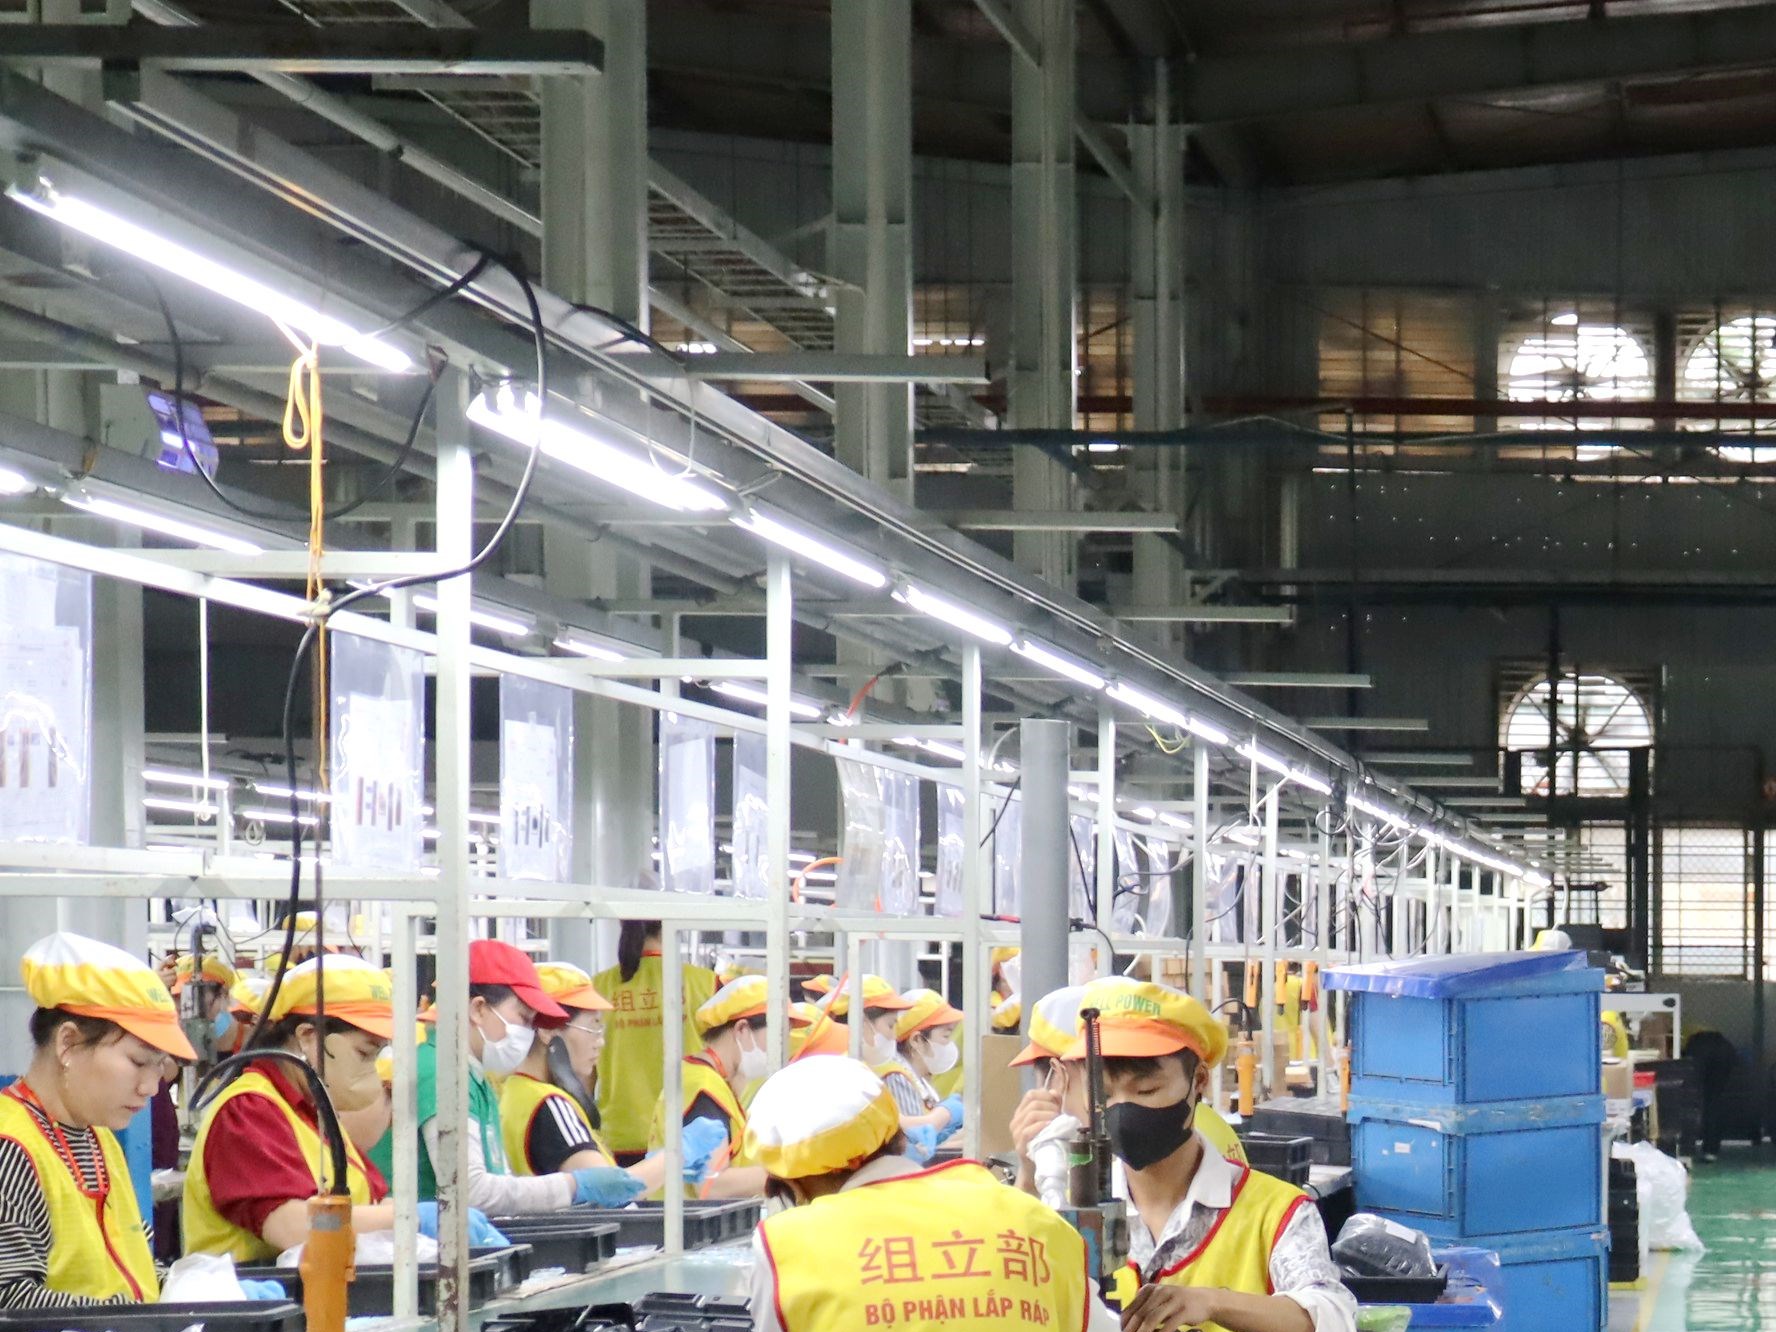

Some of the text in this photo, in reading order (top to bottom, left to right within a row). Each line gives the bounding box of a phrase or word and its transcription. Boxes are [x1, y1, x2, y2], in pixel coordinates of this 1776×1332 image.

[1116, 993, 1161, 1016] POWER
[858, 1229, 1050, 1287] 组立部
[865, 1289, 1050, 1329] BỘ PHẬN LẮP RÁP
